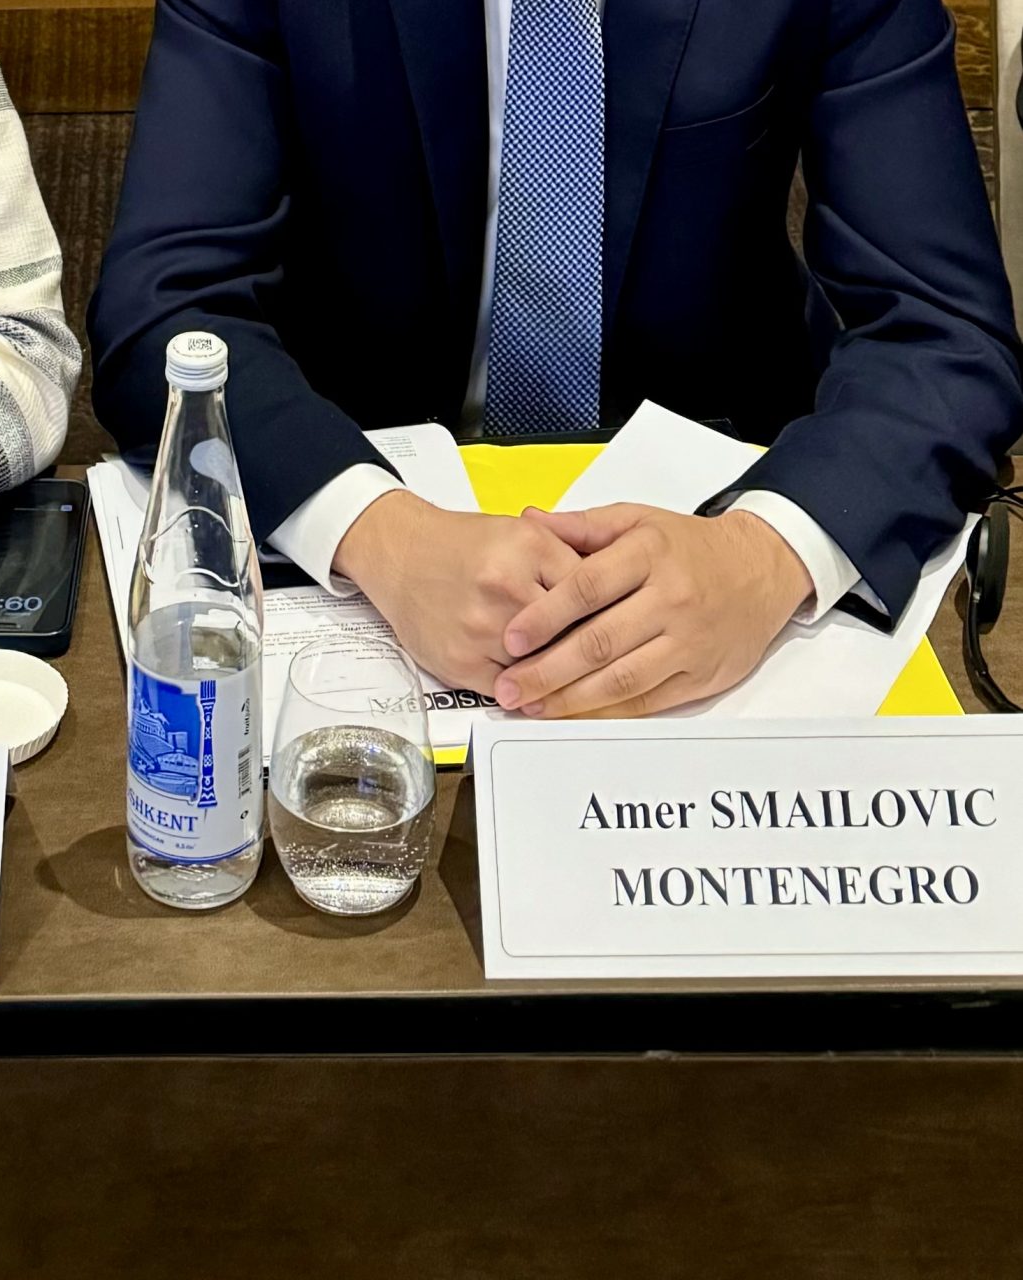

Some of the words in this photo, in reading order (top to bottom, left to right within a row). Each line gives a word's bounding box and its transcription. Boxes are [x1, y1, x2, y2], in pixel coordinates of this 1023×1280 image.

[127, 788, 198, 832] SHKENT
[579, 792, 696, 830] Amer
[710, 788, 997, 829] SMAILOVIC
[613, 865, 979, 907] MONTENEGRO
